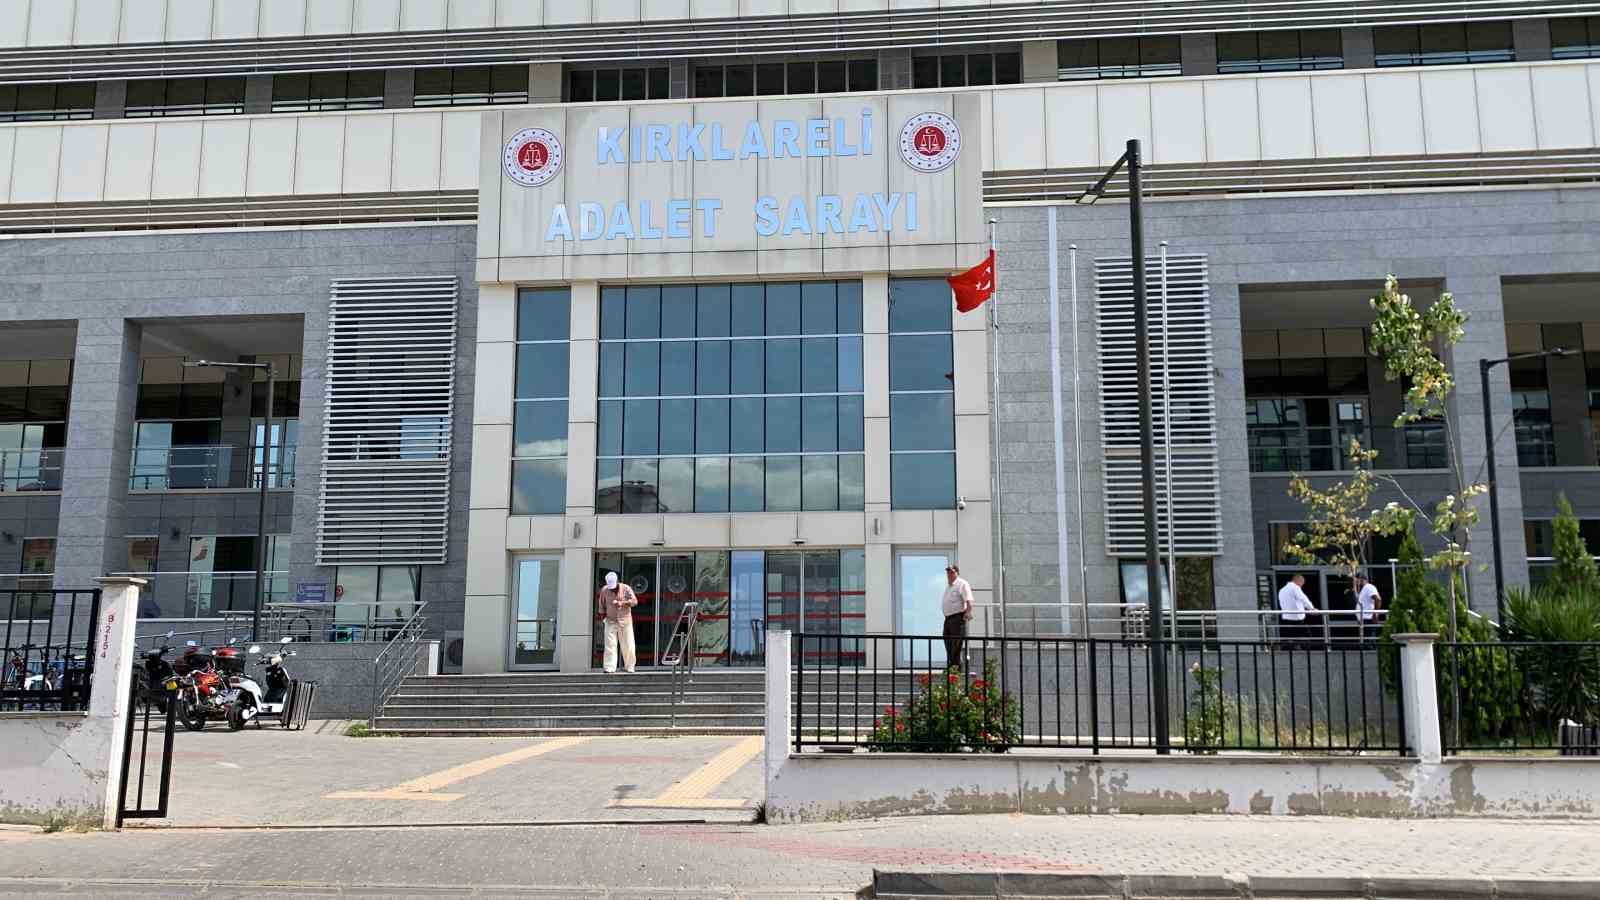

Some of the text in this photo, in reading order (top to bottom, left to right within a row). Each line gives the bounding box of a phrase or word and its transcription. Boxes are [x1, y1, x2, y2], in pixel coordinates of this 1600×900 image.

[597, 108, 873, 164] KIRKLARELİ
[545, 191, 919, 241] ADALET SARAYI
